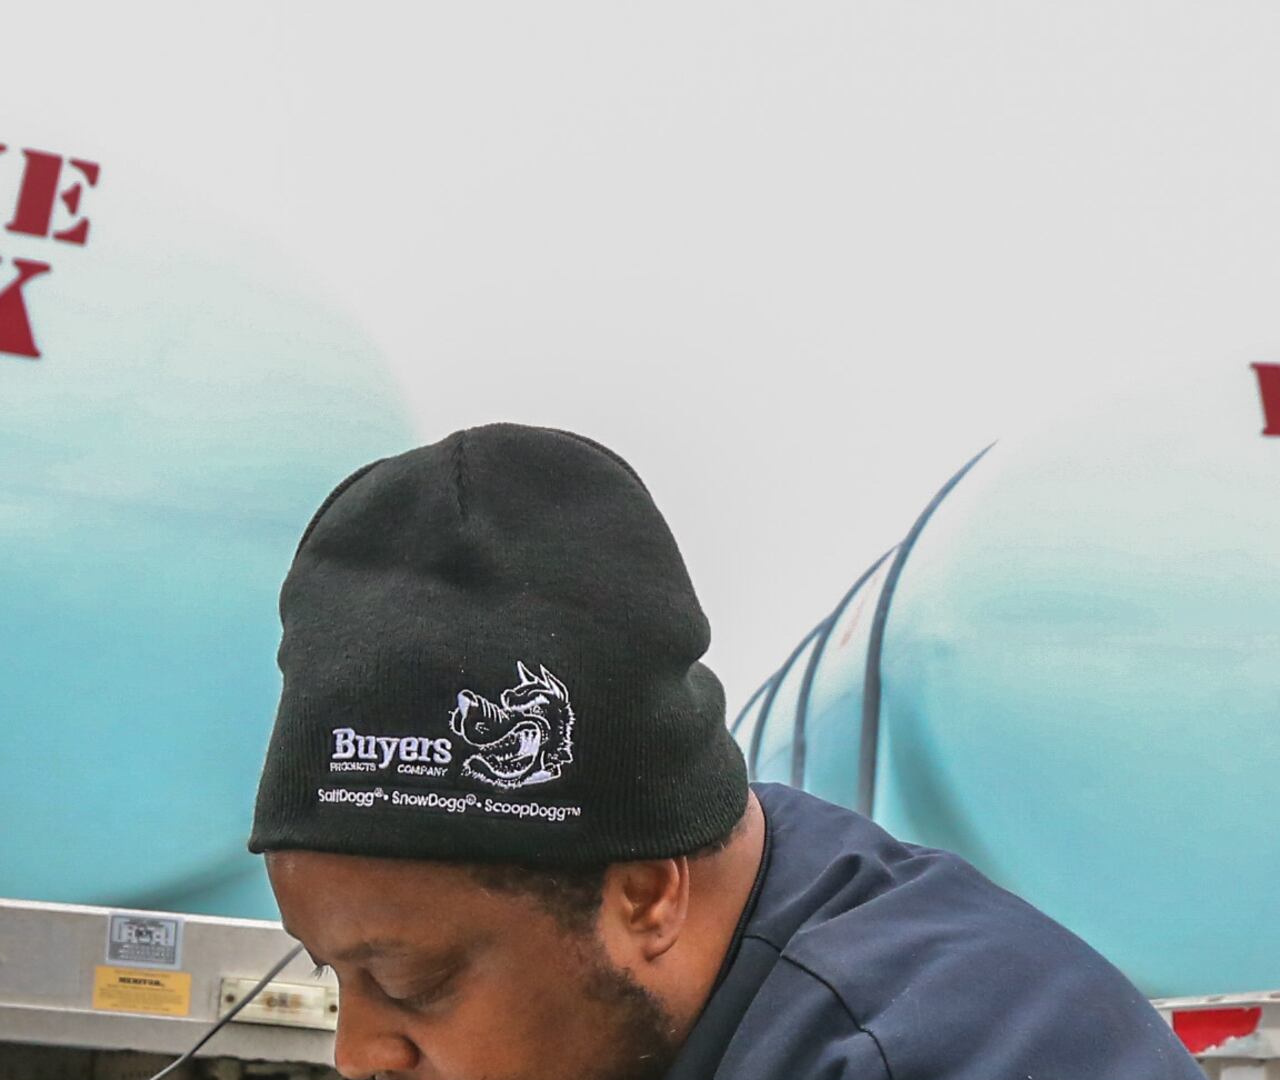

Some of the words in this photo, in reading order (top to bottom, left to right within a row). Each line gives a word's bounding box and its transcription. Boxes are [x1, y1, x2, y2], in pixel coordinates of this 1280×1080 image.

[332, 728, 452, 769] Buyers
[330, 761, 376, 772] PRODUCTS
[397, 764, 448, 777] COMPANY
